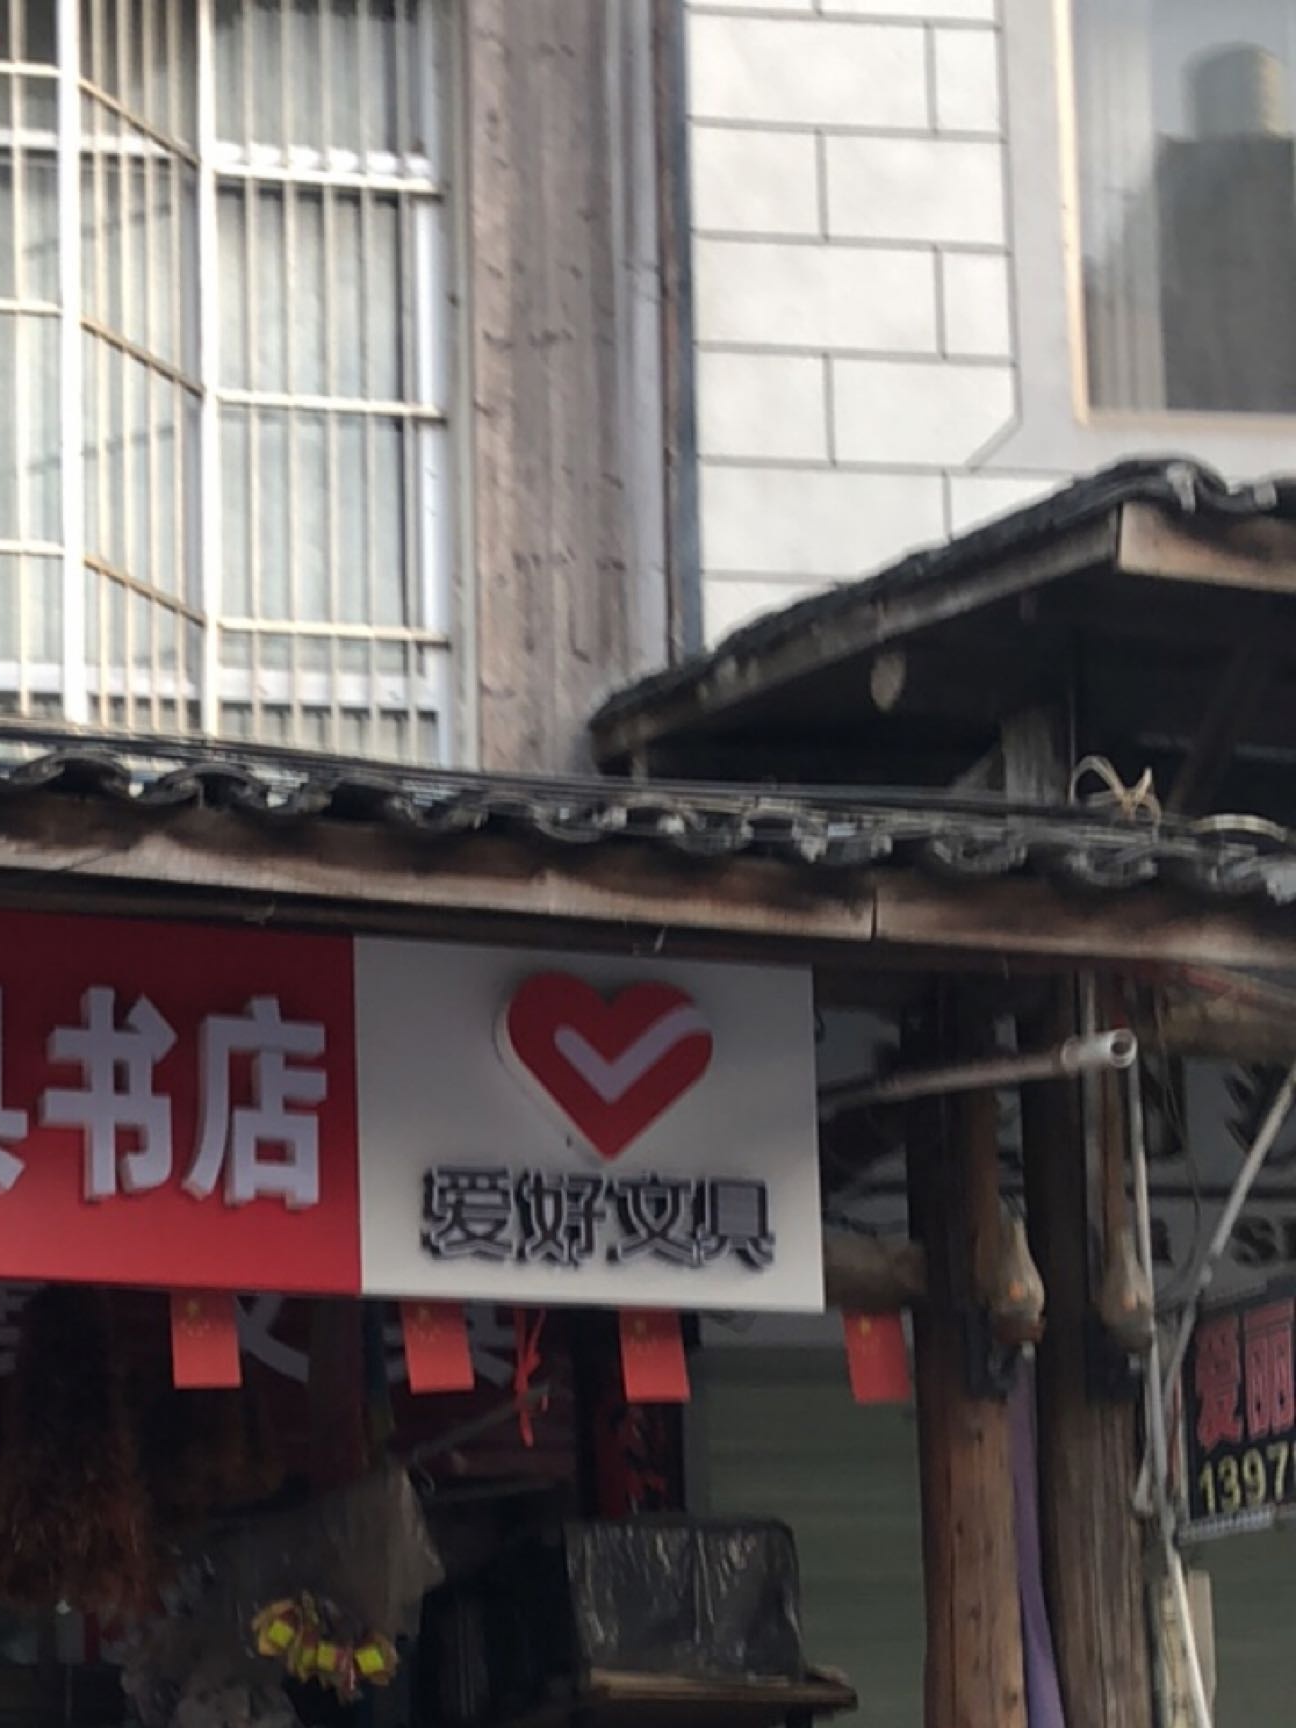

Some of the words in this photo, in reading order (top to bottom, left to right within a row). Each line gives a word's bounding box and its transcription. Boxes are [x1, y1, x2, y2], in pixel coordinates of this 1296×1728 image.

[422, 1164, 776, 1271] 爱好文具
[1198, 1440, 1296, 1518] 1397
